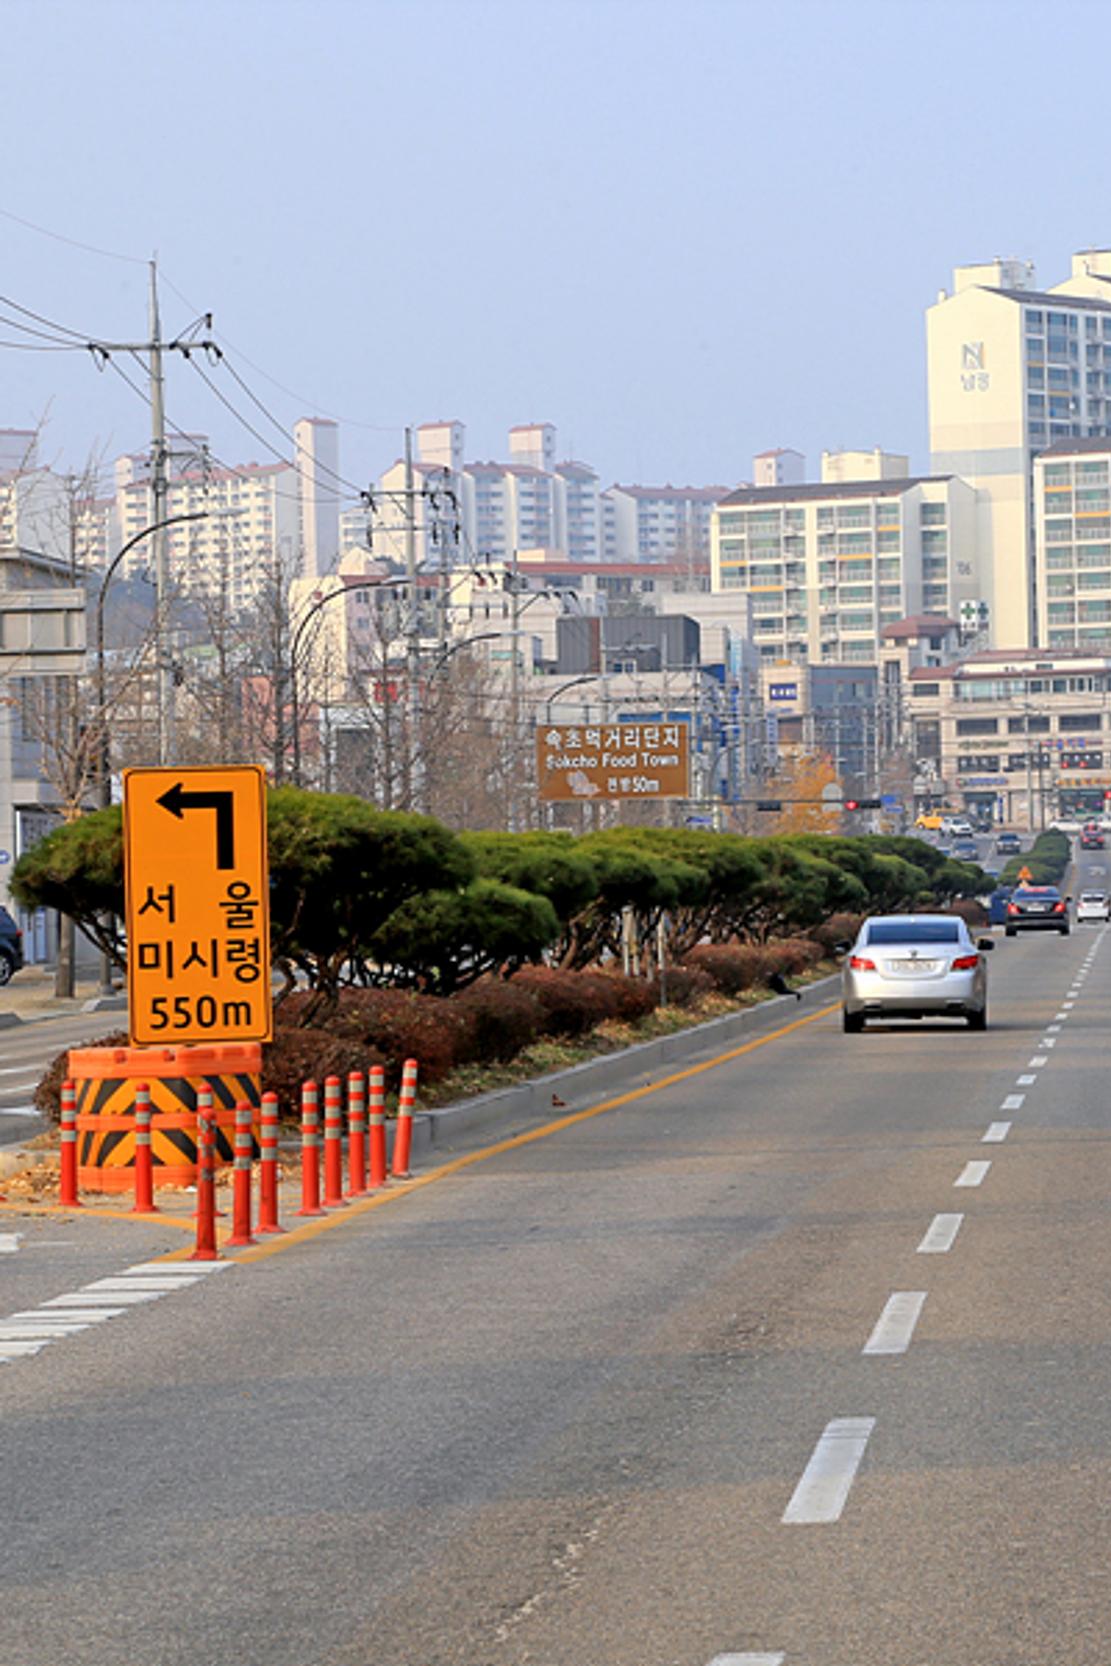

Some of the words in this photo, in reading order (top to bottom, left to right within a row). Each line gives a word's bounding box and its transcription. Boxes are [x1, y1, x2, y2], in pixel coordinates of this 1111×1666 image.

[545, 725, 679, 750] 속초먹거리단지
[546, 754, 598, 769] Sokcho
[602, 752, 637, 768] Food
[641, 752, 679, 767] Town
[138, 937, 260, 983] 미시령
[150, 994, 251, 1030] 550m
